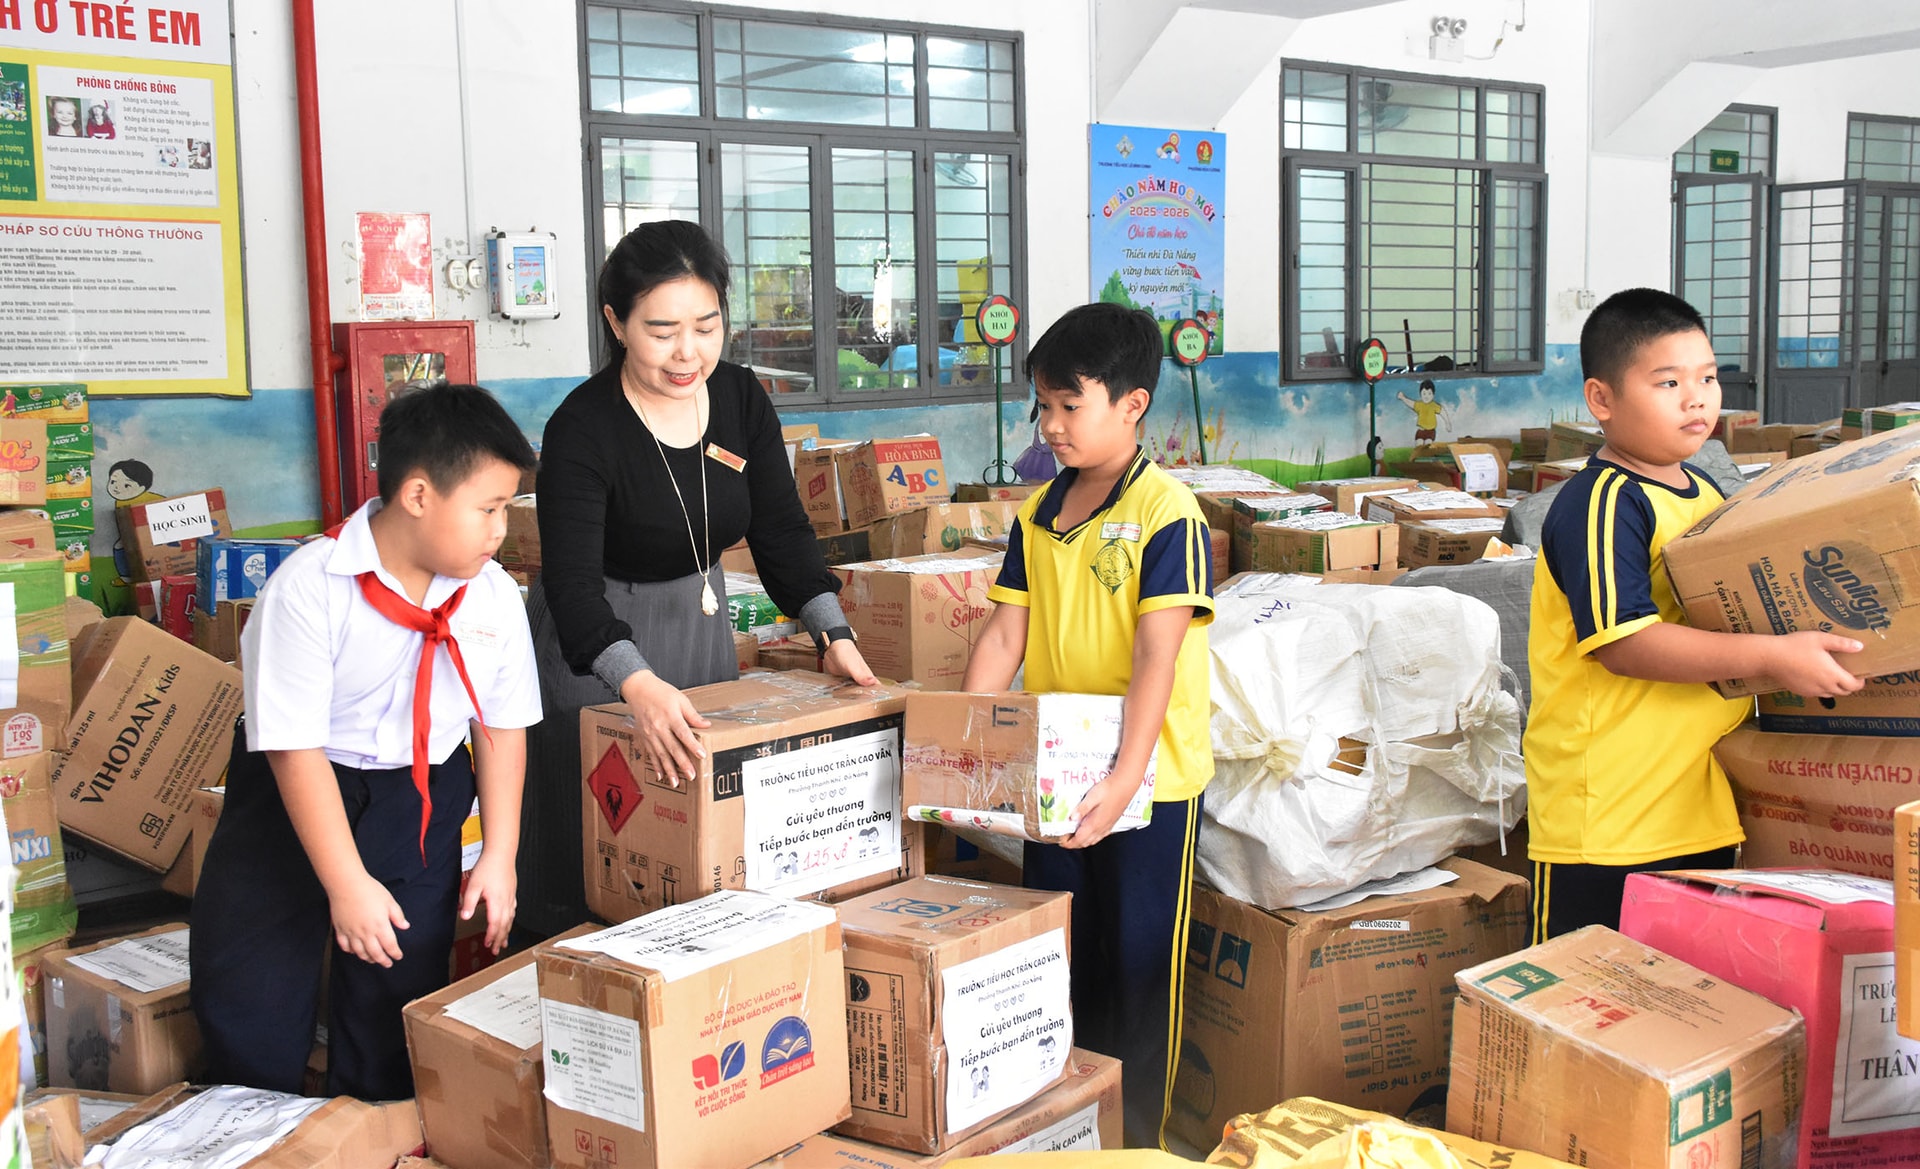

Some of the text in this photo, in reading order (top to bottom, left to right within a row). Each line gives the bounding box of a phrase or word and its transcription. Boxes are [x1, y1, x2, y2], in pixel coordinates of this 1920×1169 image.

[148, 8, 201, 46] EM
[76, 76, 111, 89] PHÒNG
[114, 77, 147, 92] CHỐNG
[1103, 175, 1216, 222] CHÀO NĂM HỌC MỚI
[1130, 206, 1189, 217] 2025 2026
[39, 225, 59, 236] SƠ
[96, 226, 144, 238] THÔNG
[148, 227, 203, 240] THƯỜNG
[1175, 227, 1188, 239] học
[1148, 251, 1161, 259] nhi
[1163, 250, 1174, 259] Đà
[992, 321, 1008, 330] HAI
[885, 449, 937, 462] HÒA BÌNH
[169, 502, 185, 513] VỞ
[808, 503, 819, 511] Lau
[153, 515, 207, 531] HỌC SINH
[1758, 554, 1777, 580] HOA
[1767, 580, 1783, 598] HẠ
[1789, 572, 1801, 590] Làm
[1803, 546, 1892, 632] Sunlight
[1714, 579, 1723, 588] 3
[1725, 610, 1737, 624] 3,6
[1776, 598, 1787, 608] &
[1812, 579, 1851, 620] Lau Sàn
[951, 604, 985, 628] Solite
[76, 720, 89, 737] 125
[84, 709, 96, 722] ml
[79, 661, 181, 812] VIHODAN Kids
[129, 765, 143, 781] Số:
[798, 763, 815, 779] TIỂU
[817, 763, 834, 775] HỌC
[836, 754, 857, 769] TRẦN
[858, 754, 874, 765] CAO
[875, 748, 892, 760] VÂN
[1768, 758, 1913, 786] CHUYỂN NHẸ TAY
[69, 778, 86, 800] Siro
[672, 809, 687, 827] micro
[806, 808, 825, 824] yêu
[1766, 808, 1808, 824] ORION
[1837, 804, 1884, 819] ORION
[760, 835, 782, 852] Tiếp
[813, 826, 833, 840] bạn
[835, 816, 855, 832] đến
[803, 847, 830, 871] 125
[1789, 840, 1867, 863] BẢO QUẢN
[1908, 831, 1919, 894] 501 817
[663, 865, 673, 876] UP
[1001, 968, 1015, 980] HỌC
[1016, 958, 1033, 974] TRẦN
[1034, 957, 1046, 968] CAO
[1047, 950, 1060, 962] VÂN
[704, 1013, 716, 1024] BỘ
[737, 999, 752, 1013] DỤC
[753, 993, 763, 1004] VÀ
[765, 987, 780, 999] ĐÀO
[782, 982, 796, 994] TẠO
[700, 1027, 713, 1038] NHÀ
[732, 1014, 745, 1026] BẢN
[746, 1007, 761, 1020] GIÁO
[762, 1002, 774, 1014] DỤC
[774, 998, 787, 1009] VIỆT
[788, 992, 802, 1002] NAM
[996, 1018, 1012, 1035] yêu
[960, 1049, 979, 1068] Tiếp
[1002, 1037, 1019, 1051] bạn
[1390, 1074, 1409, 1089] Thế
[695, 1078, 748, 1108] KẾT NỐI TRI THỨC
[698, 1091, 746, 1118] VỚI CUỘC SỐNG
[1062, 1126, 1092, 1148] CAO VÂN
